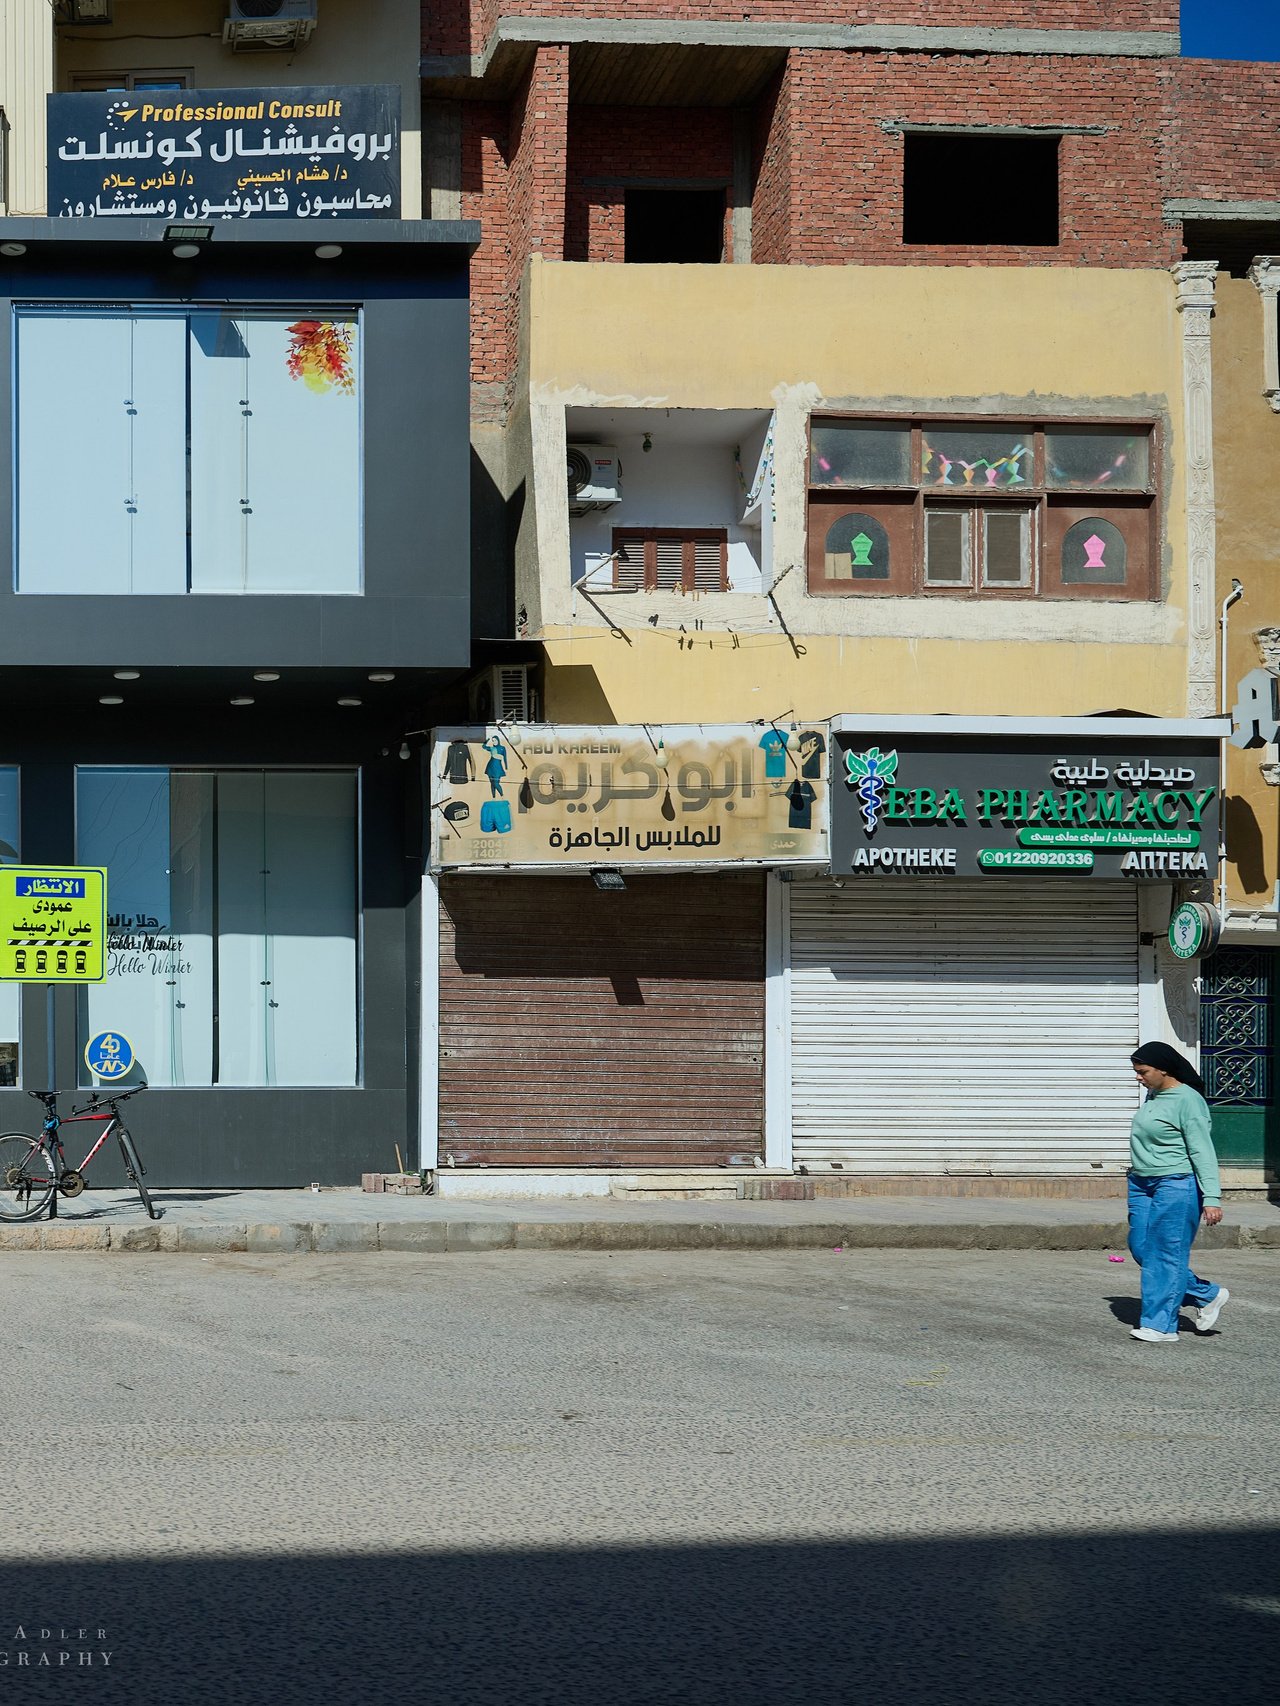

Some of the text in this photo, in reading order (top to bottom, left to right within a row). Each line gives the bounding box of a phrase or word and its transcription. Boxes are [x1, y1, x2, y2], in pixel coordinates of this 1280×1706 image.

[142, 99, 342, 122] Professional Consult
[58, 123, 392, 166] بروفيشنال كونسلت
[102, 172, 136, 190] علام
[141, 171, 175, 190] فارس
[237, 167, 291, 190] الحسيني
[296, 165, 330, 181] هشام
[183, 187, 289, 219] قانونيون
[296, 188, 392, 217] محاسبون
[558, 743, 621, 754] KAREEM
[1053, 758, 1196, 787] صيدلية طيبة
[979, 786, 1218, 825] PHARMACY
[549, 826, 721, 853] للملابس الجاهزة
[854, 847, 957, 868] APOTHEKE
[994, 852, 1093, 866] 01220920336
[22, 878, 80, 896] الانتظار
[12, 917, 92, 937] على الرصيف
[135, 913, 159, 928] هلا
